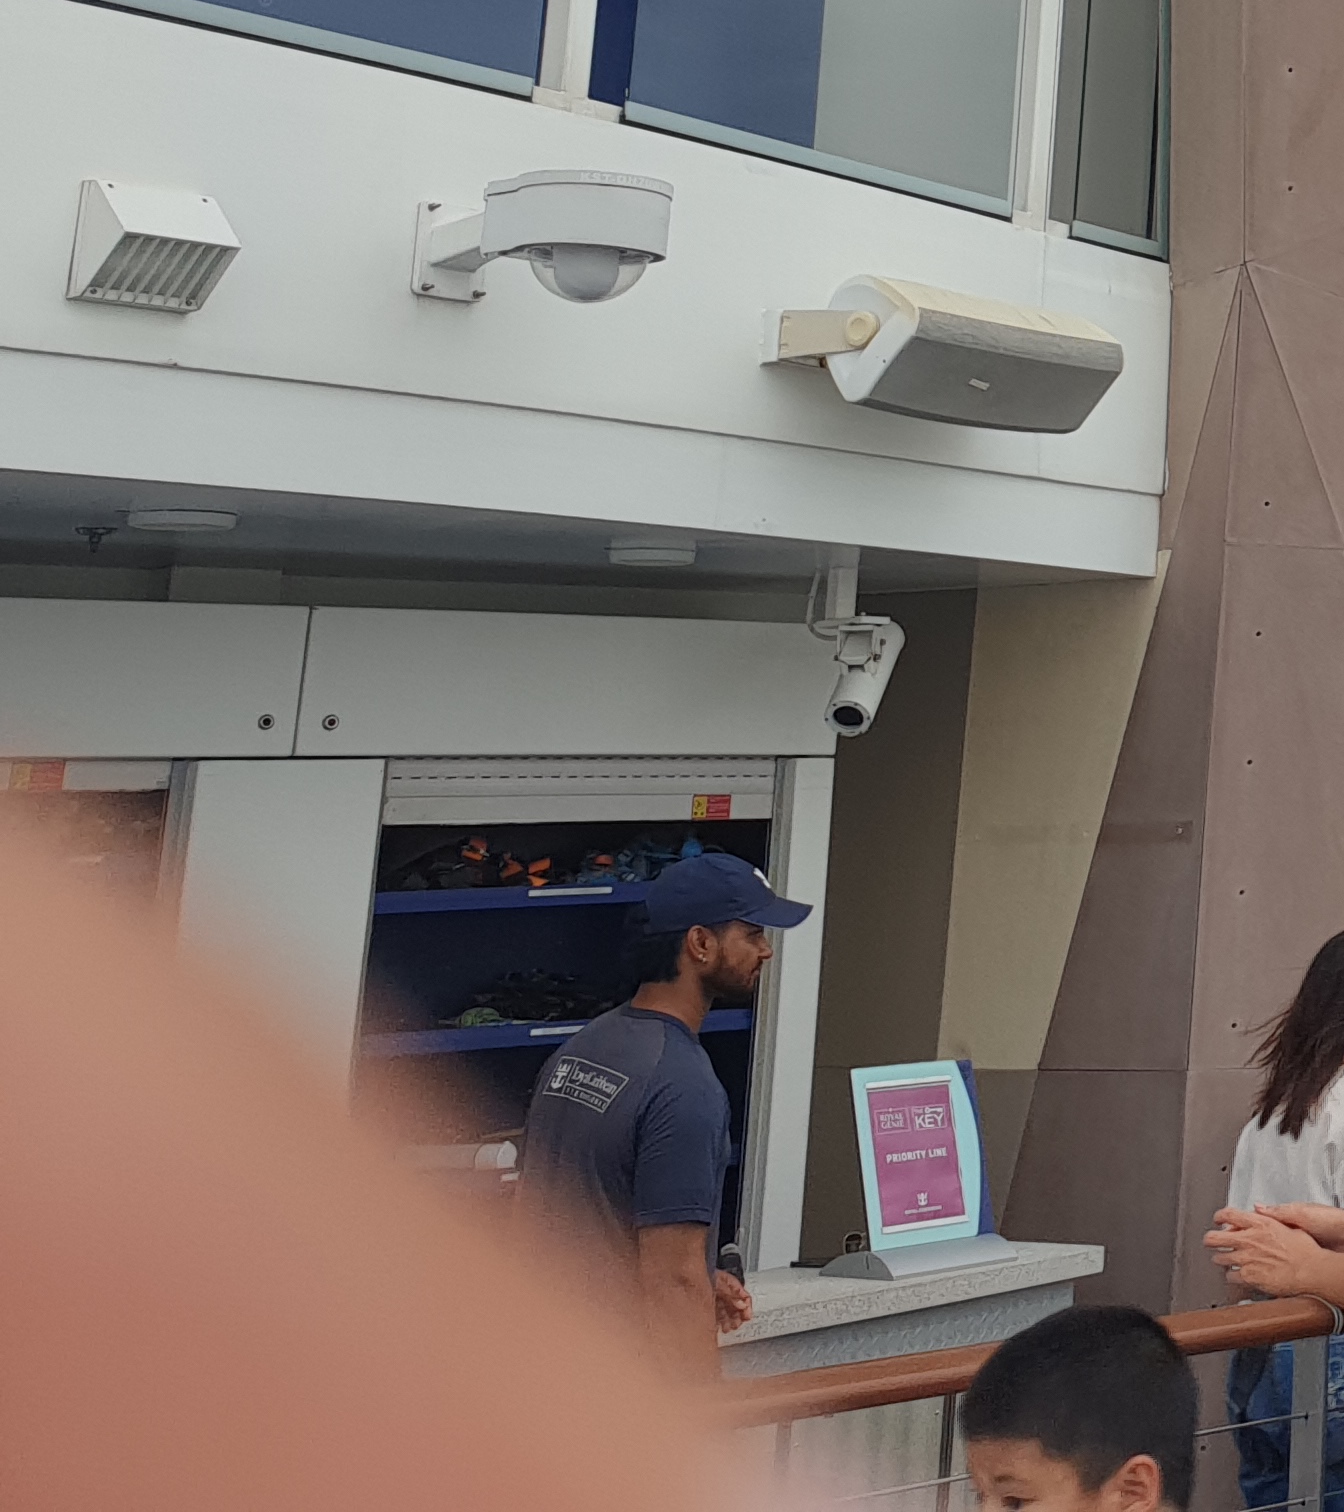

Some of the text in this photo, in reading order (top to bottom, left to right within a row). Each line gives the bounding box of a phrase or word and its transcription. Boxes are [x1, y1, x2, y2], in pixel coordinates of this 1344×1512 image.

[915, 1113, 944, 1130] KEY
[885, 1146, 948, 1165] PRIORITY LINE
